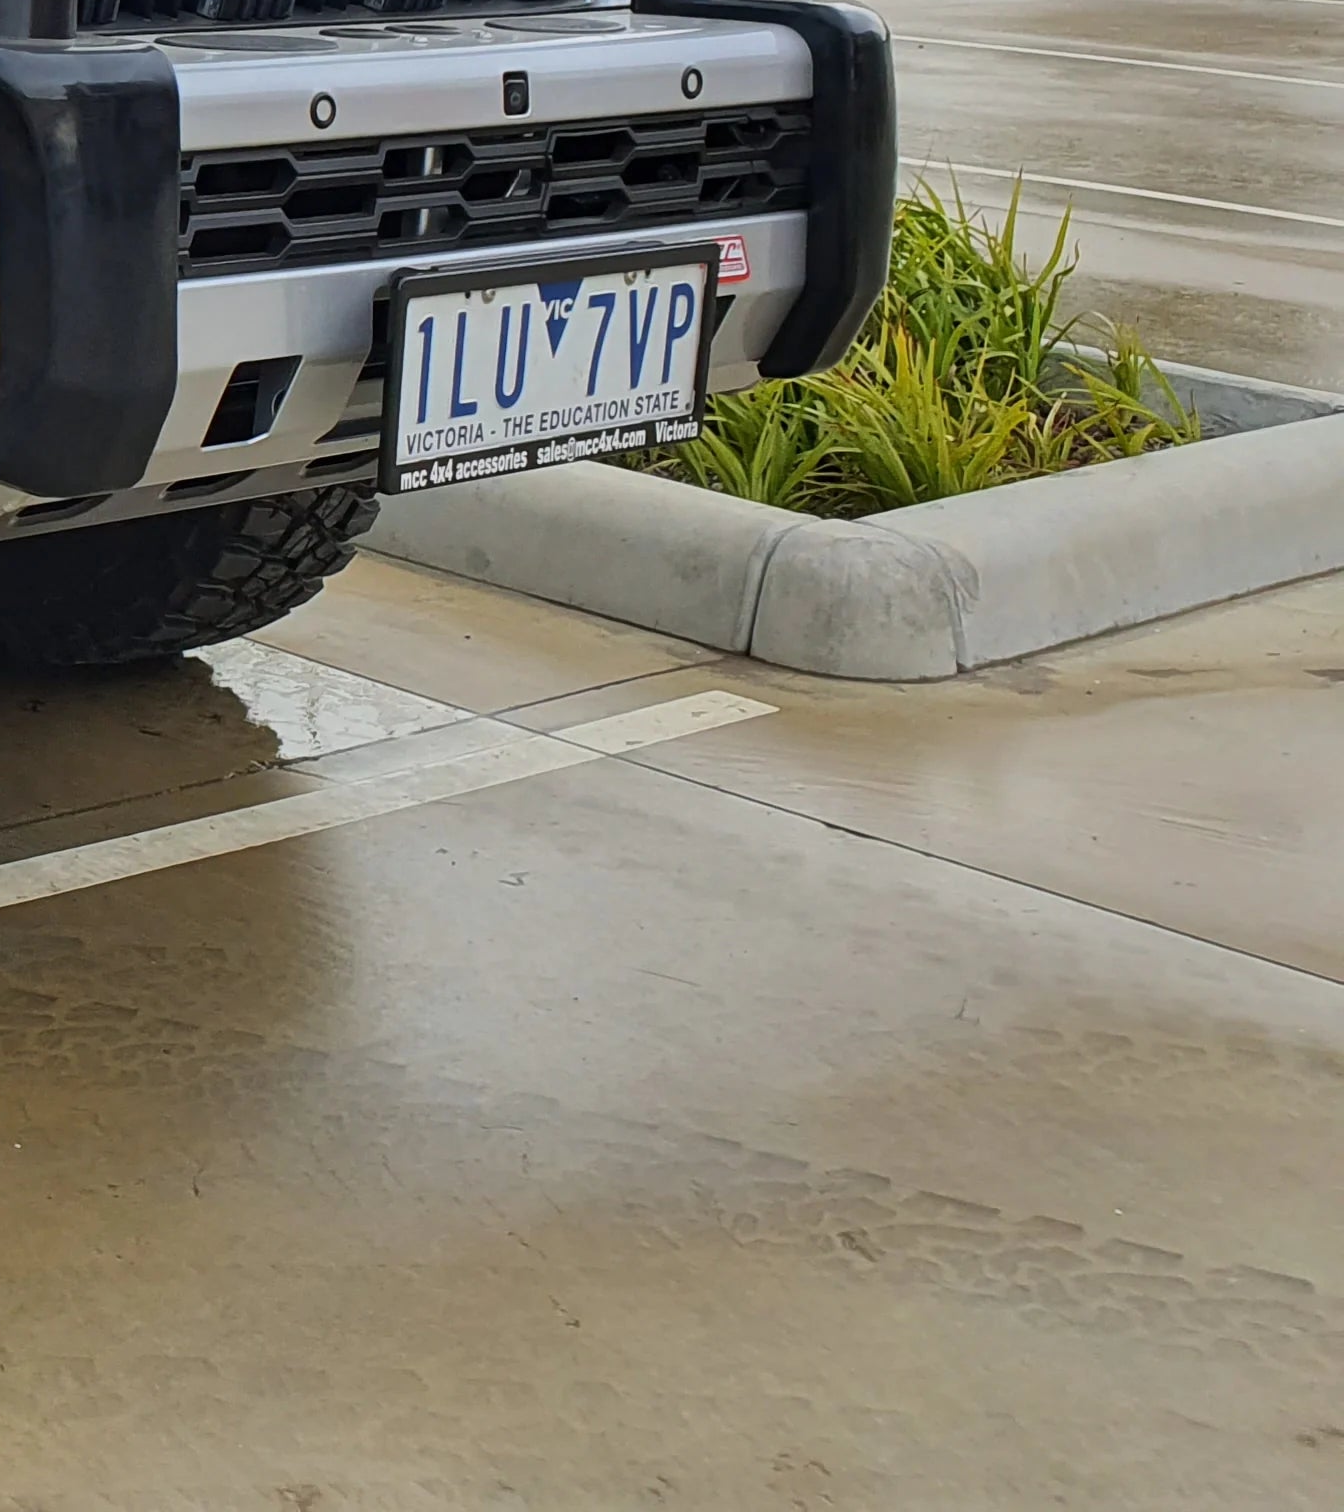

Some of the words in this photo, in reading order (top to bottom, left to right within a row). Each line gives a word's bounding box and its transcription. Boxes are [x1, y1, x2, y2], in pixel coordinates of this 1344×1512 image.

[542, 298, 573, 320] VIC
[400, 468, 428, 491] mcc
[430, 458, 454, 484] 4x4
[455, 447, 528, 481] accessories
[536, 428, 646, 465] sales@mcc4x4.com
[655, 415, 699, 444] Victoria
[406, 422, 484, 455] VICTORIA
[502, 413, 534, 438] THE
[539, 398, 630, 432] EDUCATION
[634, 390, 680, 416] STATE
